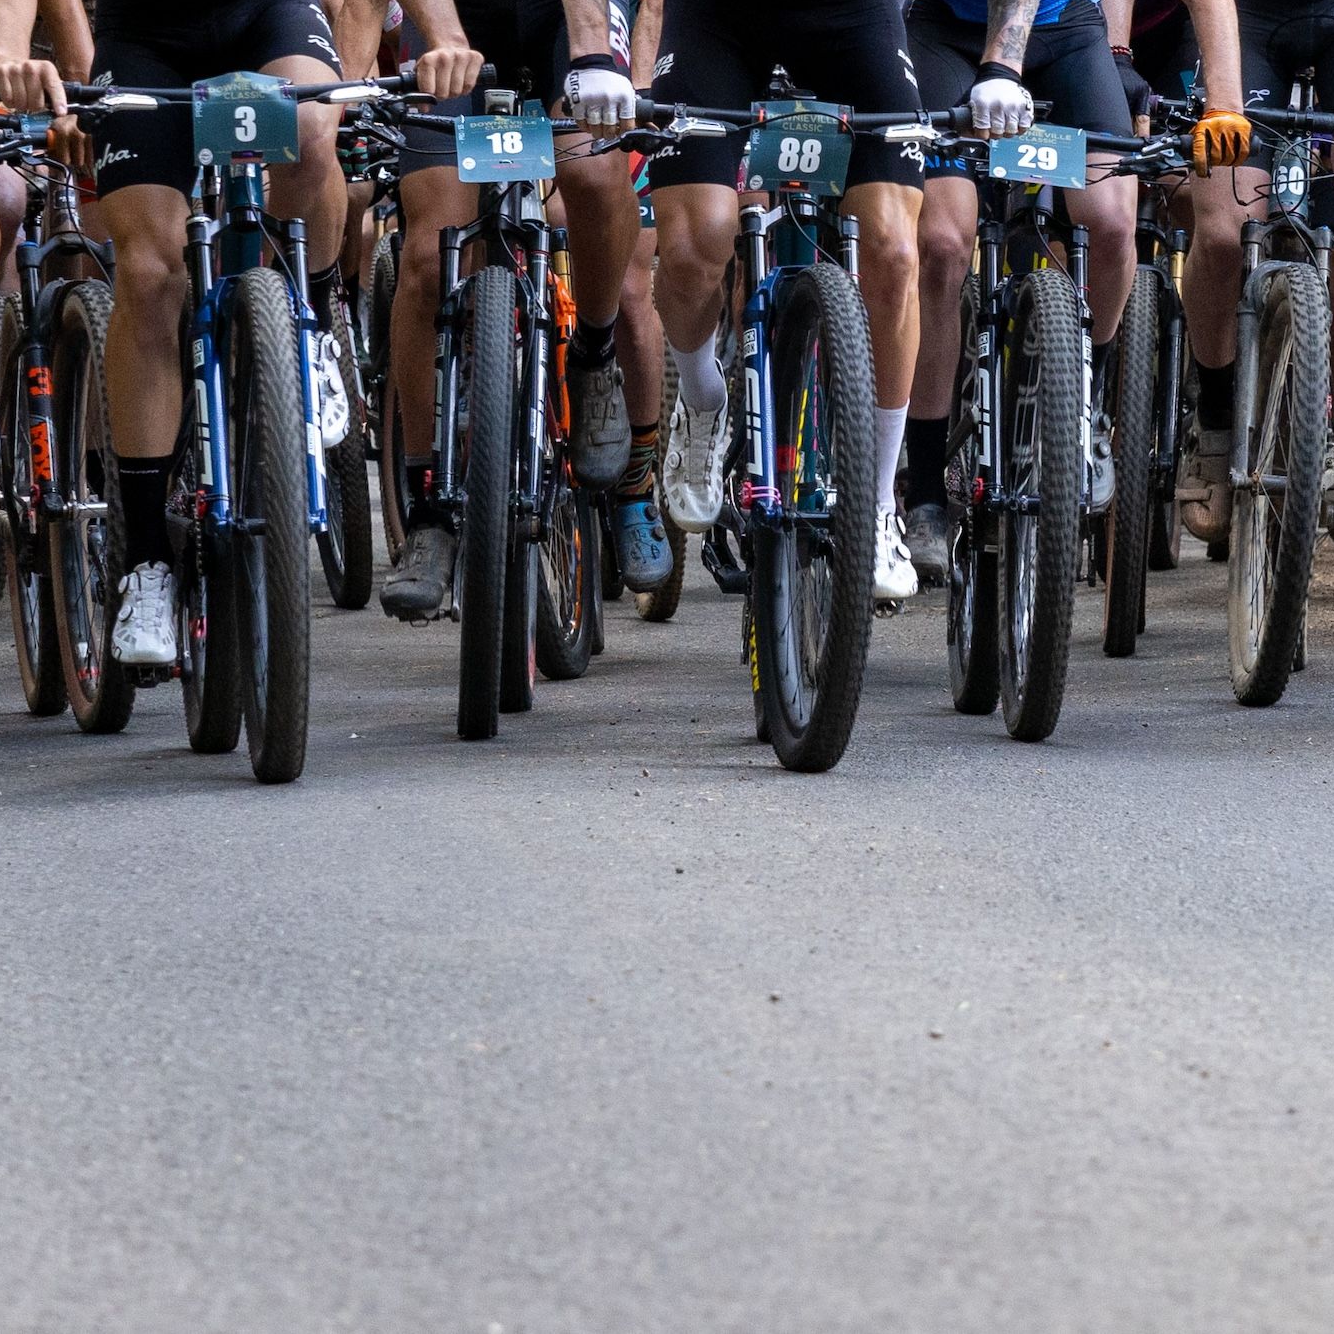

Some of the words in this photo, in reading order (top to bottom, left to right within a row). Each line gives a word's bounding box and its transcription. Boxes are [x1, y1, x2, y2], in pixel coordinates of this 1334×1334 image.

[570, 71, 581, 105] GIRO
[235, 106, 257, 142] 3
[752, 128, 760, 145] PRO
[782, 122, 823, 133] CLASSIC
[486, 131, 523, 154] 18
[1019, 136, 1057, 145] CLASSIC
[778, 137, 822, 173] 88
[1017, 144, 1058, 171] 29
